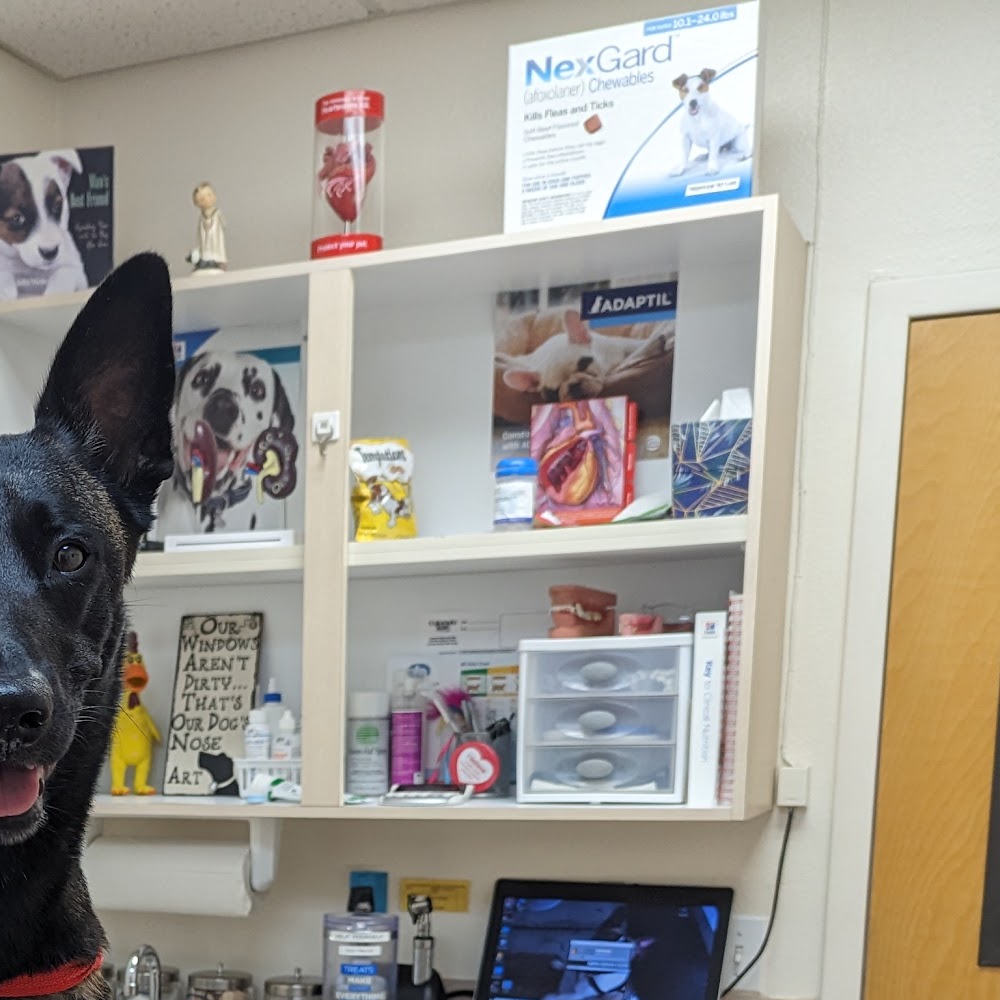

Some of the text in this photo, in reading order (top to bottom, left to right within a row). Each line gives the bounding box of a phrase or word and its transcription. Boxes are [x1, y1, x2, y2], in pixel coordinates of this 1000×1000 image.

[525, 35, 672, 86] NexGard
[588, 69, 655, 94] Chewables
[523, 99, 615, 122] Kills Fleas and Ticks
[600, 292, 672, 313] ADAPTIL
[201, 617, 239, 635] OUR
[181, 635, 260, 653] WINDOWS
[183, 654, 249, 672] AREN'T
[703, 659, 713, 678] Key
[184, 674, 248, 691] DIRTY...
[182, 693, 243, 711] THAT'S
[171, 713, 249, 731] OUR DOG'S
[171, 733, 222, 752] NOSE
[167, 767, 203, 785] ART
[343, 965, 374, 974] TREATS
[347, 976, 372, 985] MAKE
[335, 991, 387, 1000] EVERYTHING
